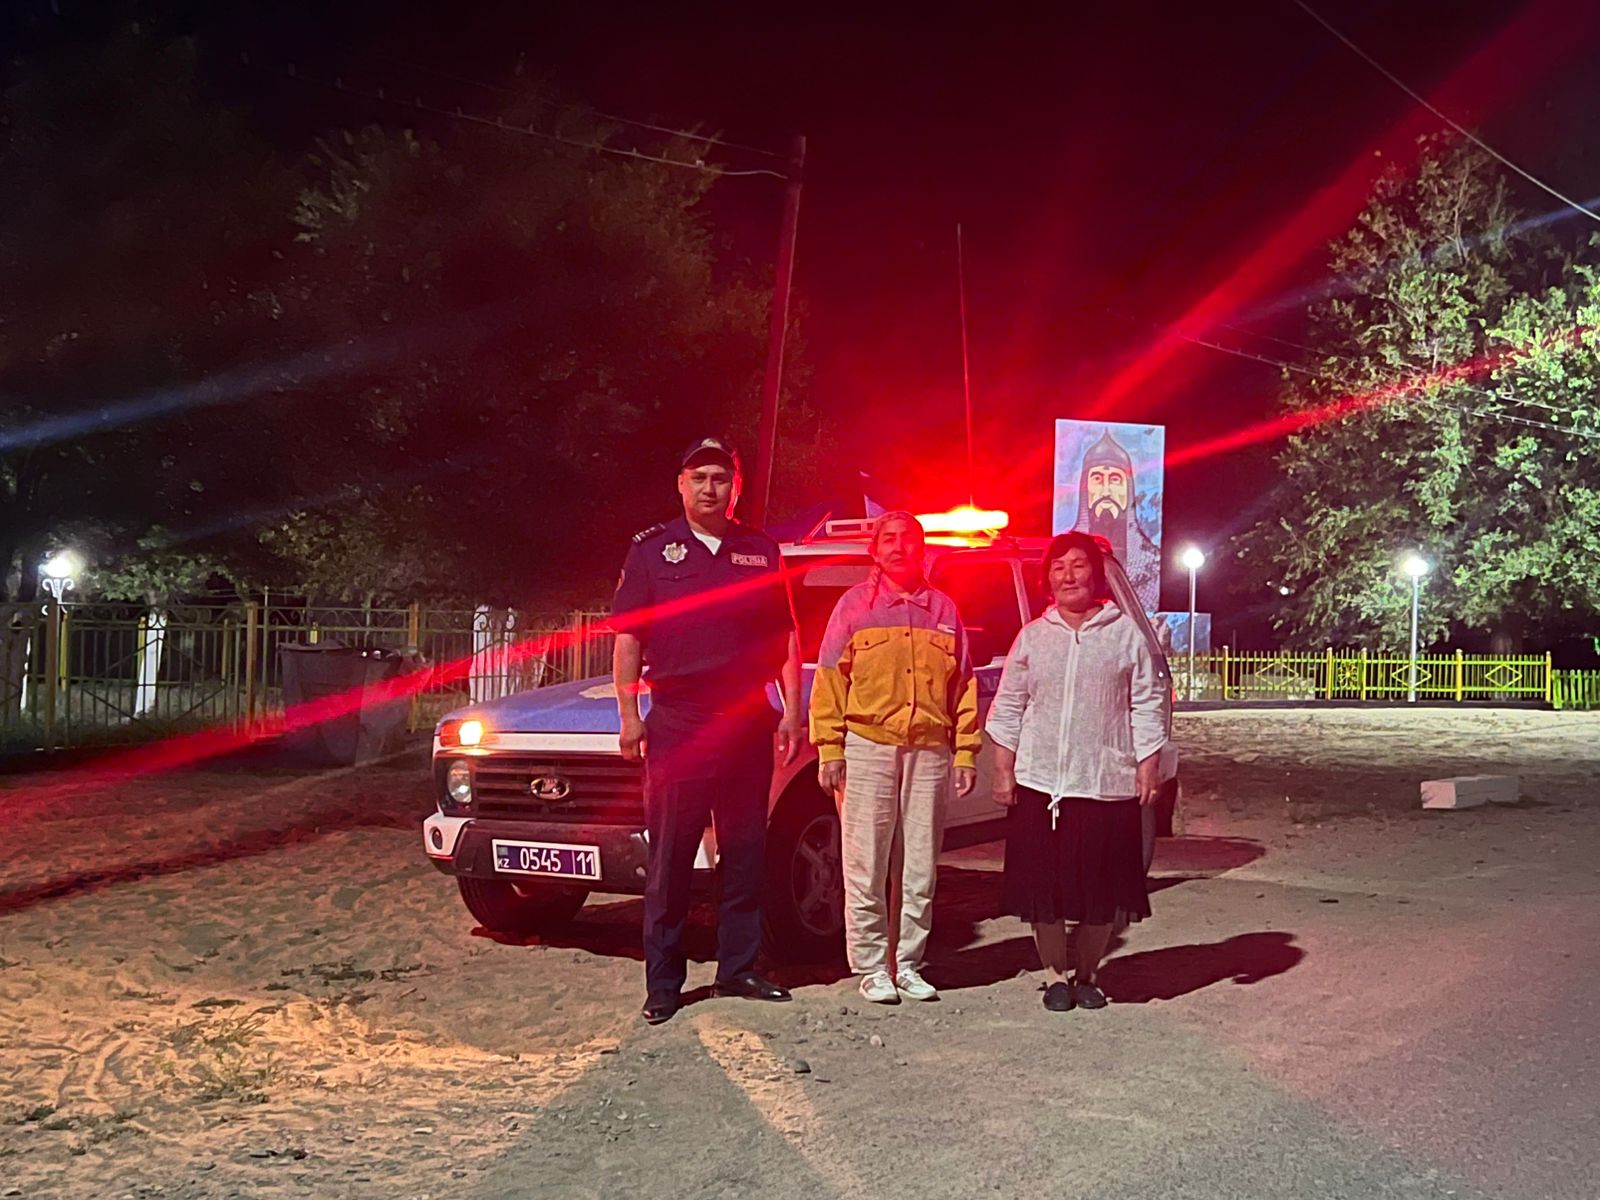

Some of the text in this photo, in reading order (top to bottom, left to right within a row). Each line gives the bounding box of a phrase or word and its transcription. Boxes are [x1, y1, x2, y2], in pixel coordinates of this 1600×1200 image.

[498, 847, 595, 875] KZ 0545 11
